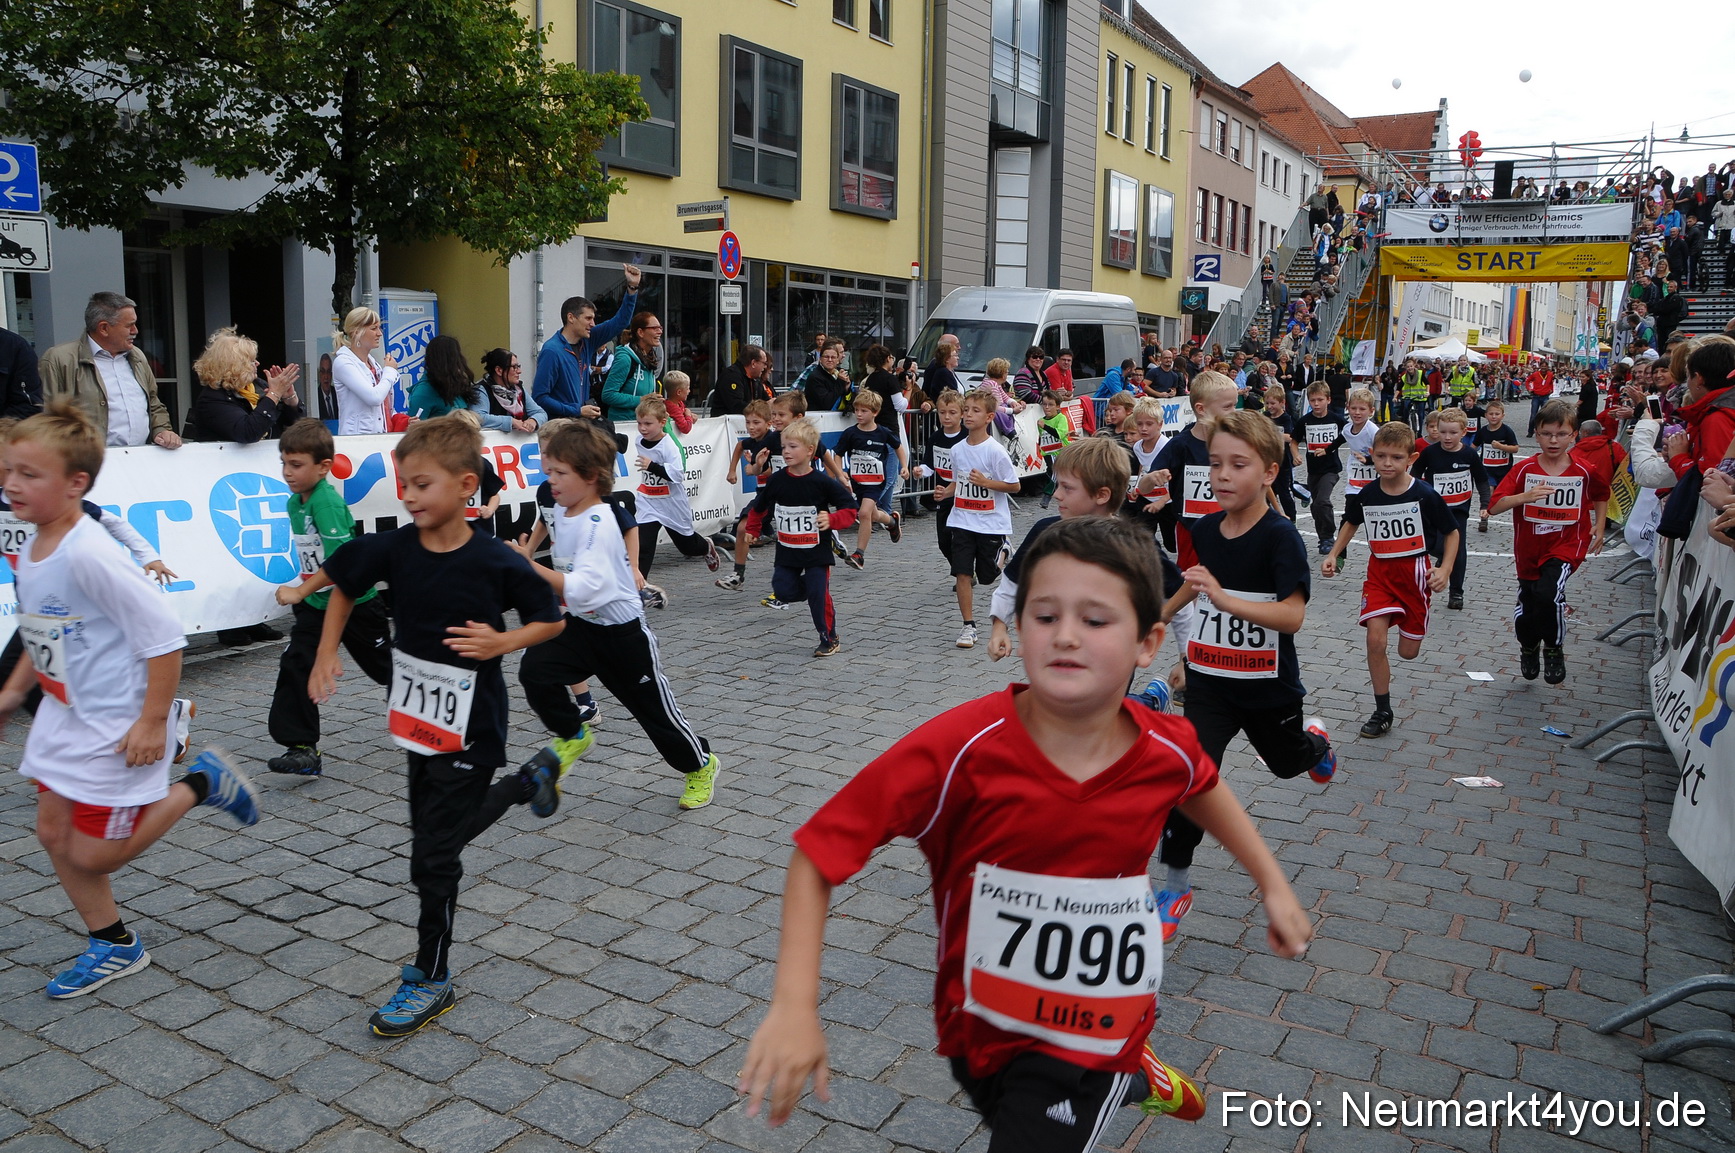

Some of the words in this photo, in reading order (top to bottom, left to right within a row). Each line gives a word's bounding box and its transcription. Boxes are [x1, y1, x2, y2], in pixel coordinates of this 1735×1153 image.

[677, 203, 723, 215] Brunnwirtsgasse
[1454, 214, 1483, 223] BMW
[1485, 212, 1583, 224] EfficientDynamics
[1457, 251, 1542, 271] START
[1398, 326, 1407, 349] Audi
[1309, 432, 1335, 443] 7165
[1486, 449, 1507, 459] 7318
[854, 463, 879, 474] 7321
[959, 481, 989, 499] 7106
[1438, 480, 1468, 495] 7303
[963, 500, 982, 509] Moritz
[778, 515, 813, 532] 7115
[1537, 509, 1566, 520] Philipp
[1370, 517, 1416, 539] 7306
[1198, 609, 1266, 648] 7185
[1193, 647, 1266, 669] Maximilian
[400, 675, 457, 726] 7119
[980, 882, 1050, 911] PARTL
[1053, 896, 1141, 916] Neumarkt
[996, 910, 1145, 987] 7096
[1034, 996, 1096, 1031] Luis
